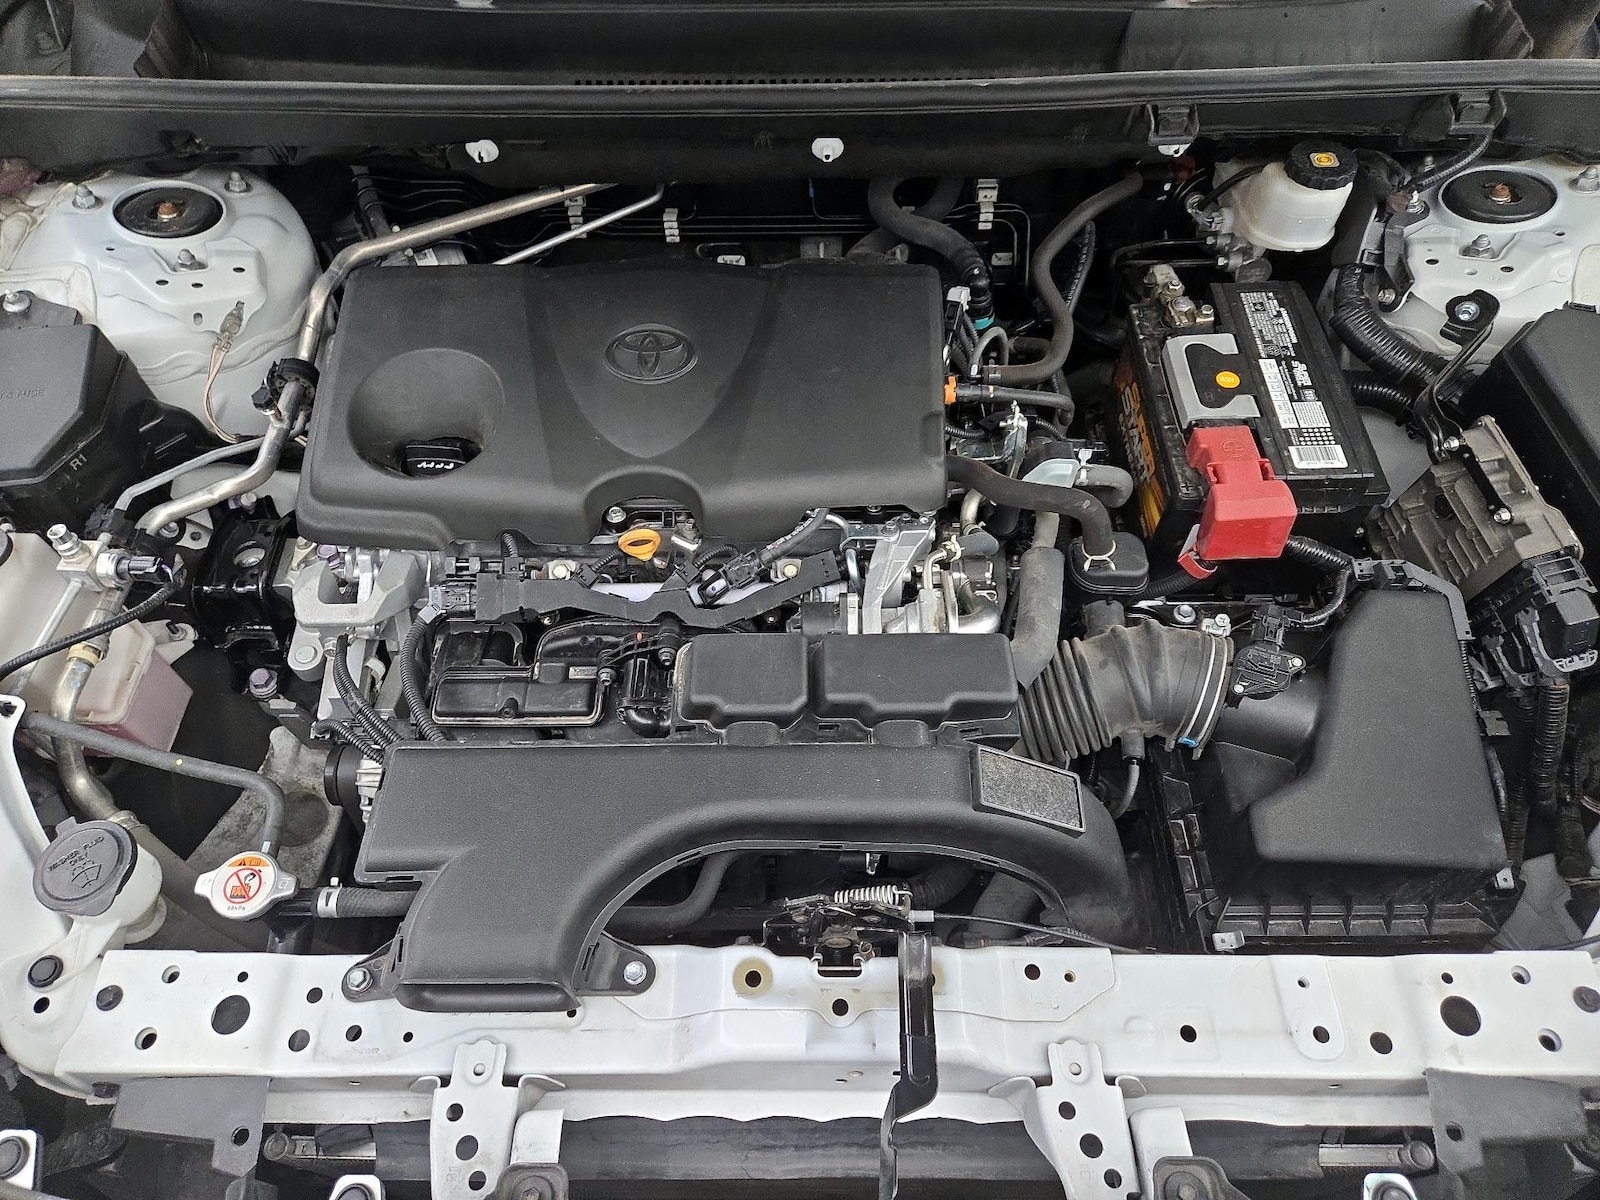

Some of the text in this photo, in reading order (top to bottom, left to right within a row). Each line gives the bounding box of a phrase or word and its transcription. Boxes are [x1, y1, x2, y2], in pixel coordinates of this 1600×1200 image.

[1121, 385, 1151, 484] START
[69, 453, 88, 471] R1
[46, 836, 105, 873] WASHER FLUID
[68, 851, 89, 867] ONLY
